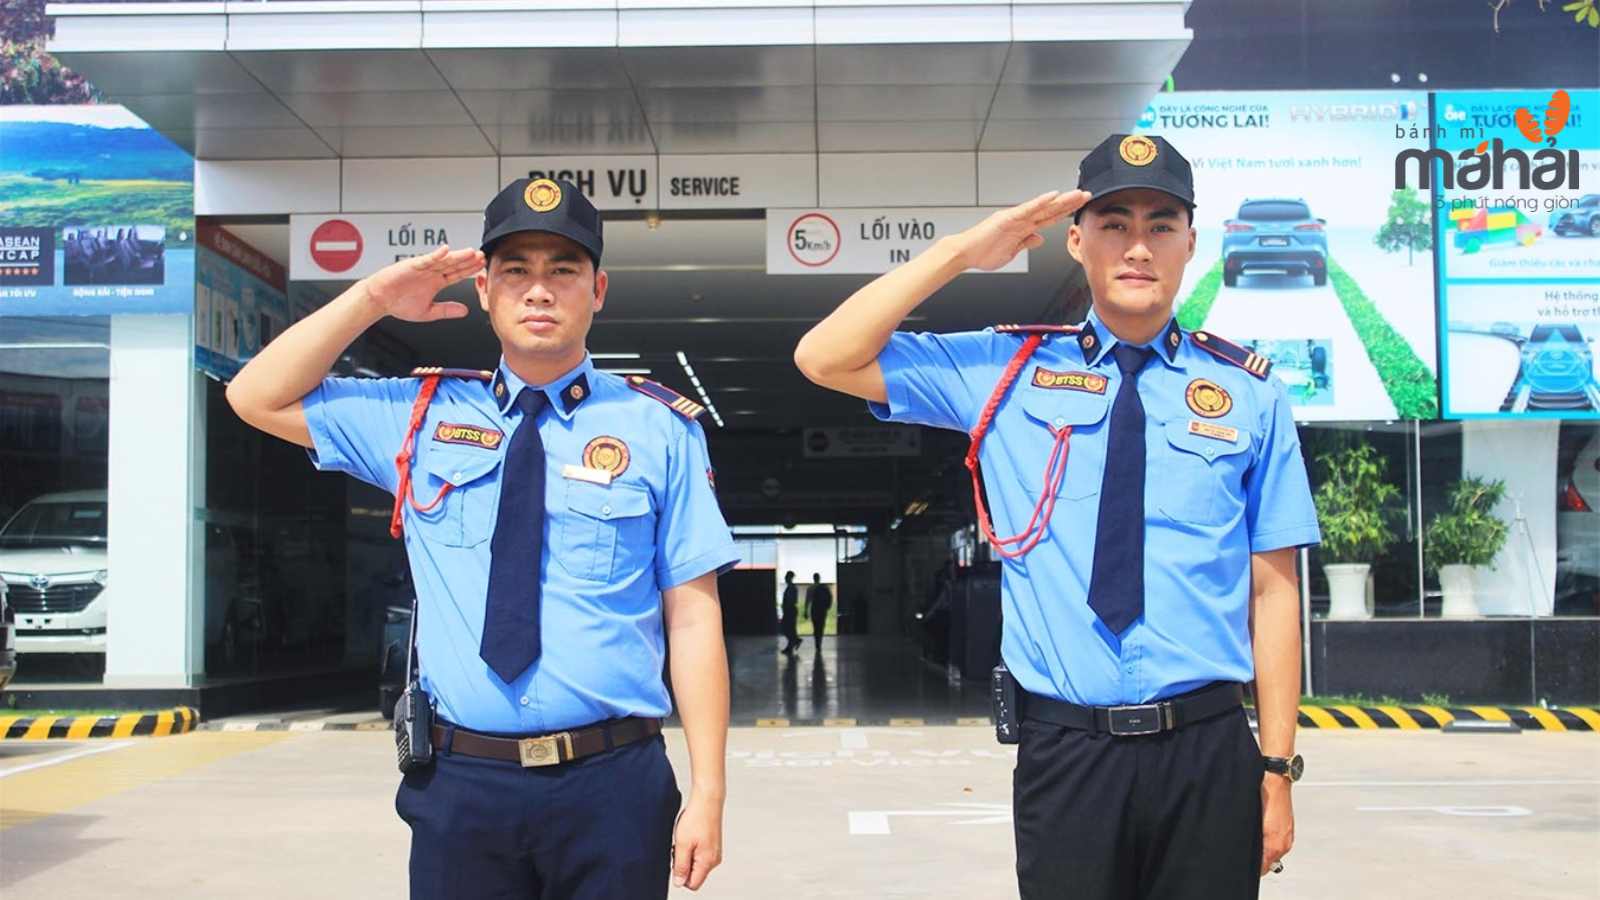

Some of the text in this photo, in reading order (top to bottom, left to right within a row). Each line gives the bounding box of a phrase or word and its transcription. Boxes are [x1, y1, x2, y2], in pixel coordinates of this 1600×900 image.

[1160, 114, 1269, 128] TƯƠNG LAI!
[1237, 158, 1265, 169] Nam
[607, 169, 647, 204] VỤ
[670, 177, 740, 196] SERVICE
[388, 222, 449, 246] LỐI RA
[860, 216, 935, 240] LỐI VÀO
[890, 249, 910, 263] IN
